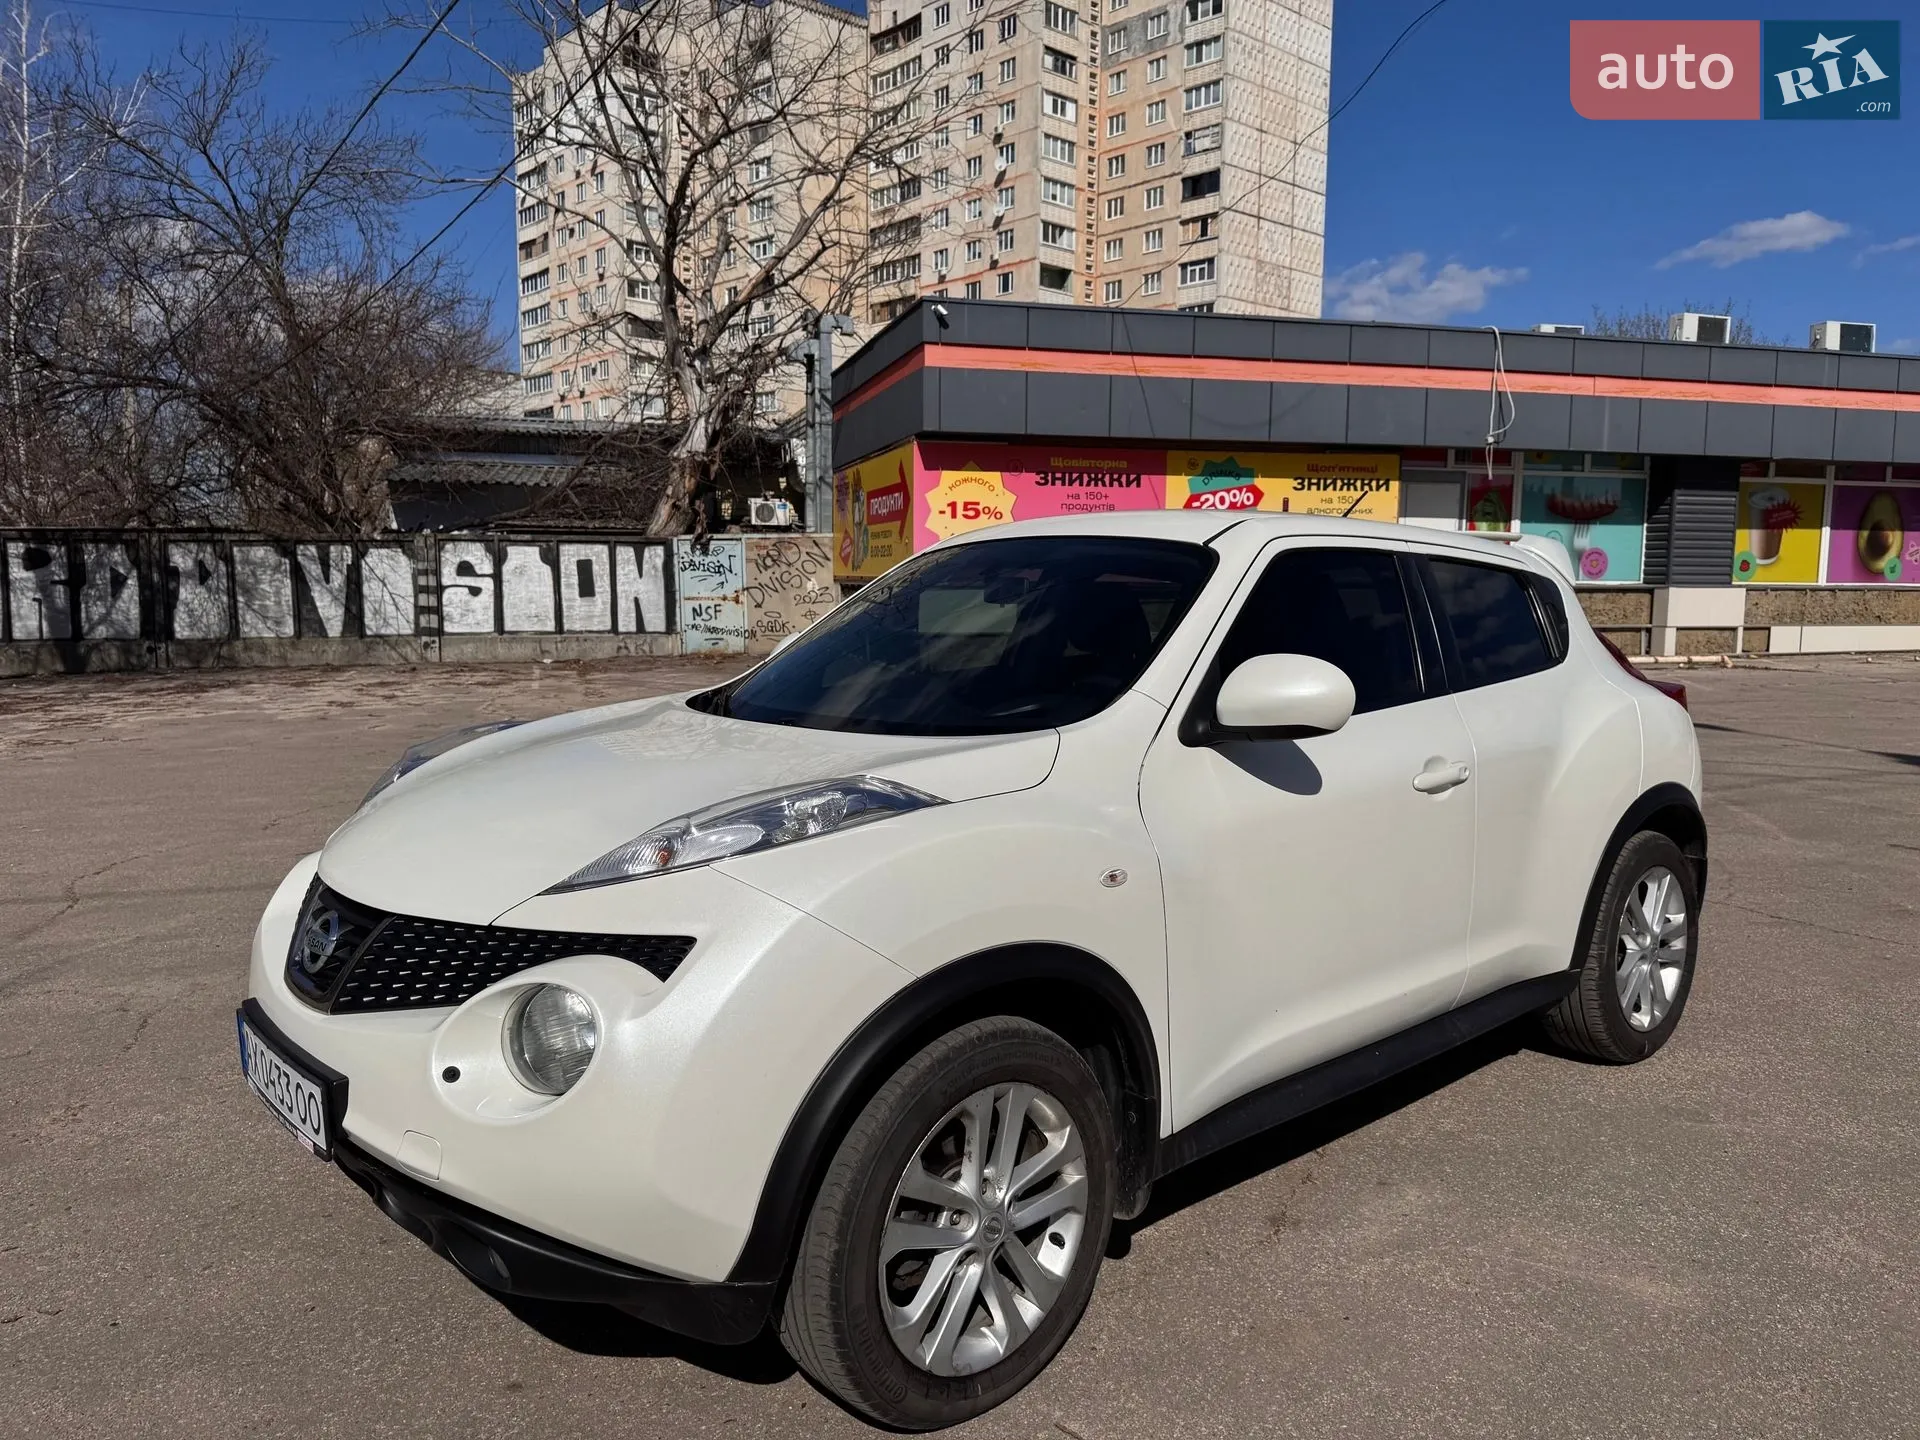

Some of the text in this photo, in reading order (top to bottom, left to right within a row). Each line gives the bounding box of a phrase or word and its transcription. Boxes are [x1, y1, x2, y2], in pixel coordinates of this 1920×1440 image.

[1050, 457, 1128, 469] Щовівторка
[1306, 463, 1378, 474] Щоп'ятниці
[1034, 471, 1142, 488] ЗНИЖКИ
[1292, 477, 1391, 492] ЗНИЖКИ
[870, 492, 904, 516] ПРОДУКТИ
[1084, 491, 1110, 501] 150+
[1191, 487, 1255, 510] -20%
[1337, 495, 1359, 505] 150
[938, 500, 1003, 521] -15%
[1060, 503, 1116, 513] продуктів
[794, 586, 834, 606] 2023
[692, 603, 722, 622] NSF
